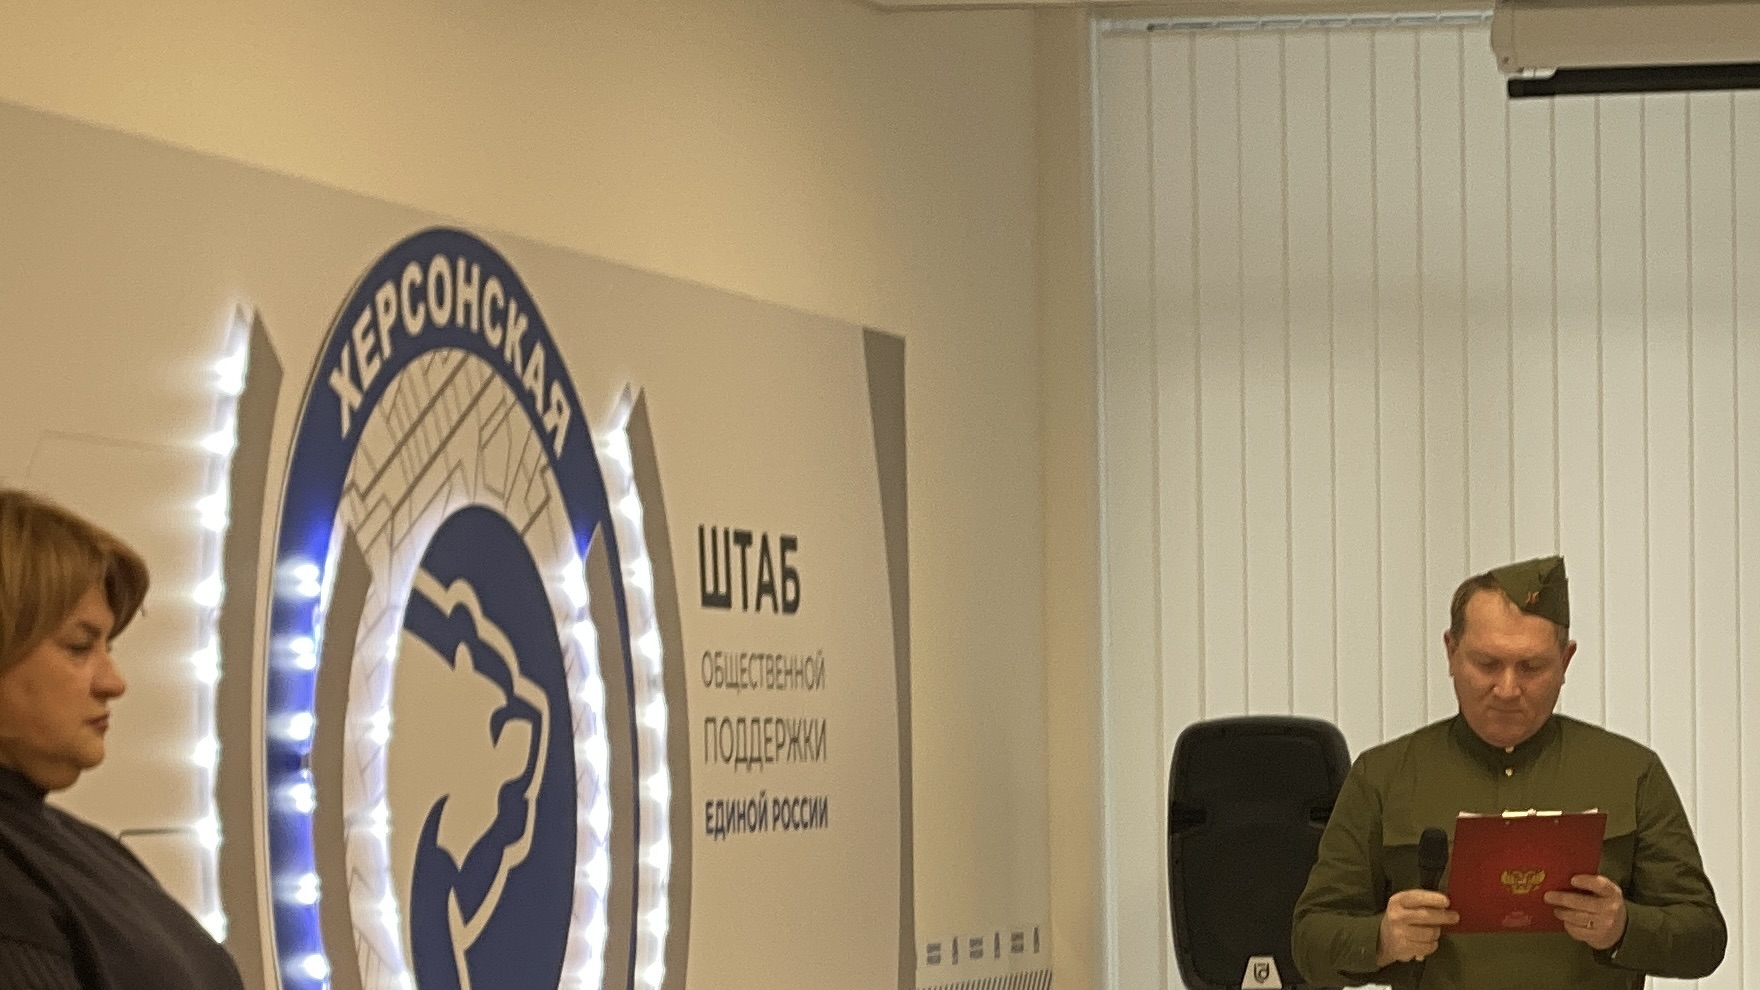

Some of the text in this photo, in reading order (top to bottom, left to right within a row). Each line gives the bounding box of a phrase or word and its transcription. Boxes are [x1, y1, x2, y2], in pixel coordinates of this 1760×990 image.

[328, 253, 571, 459] ХЕРСОНСКАЯ
[698, 523, 801, 615] ШТАБ
[701, 649, 826, 693] ОБЩЕСТВЕННОЙ
[703, 716, 828, 773] ПОДДЕРЖКИ
[704, 790, 829, 842] ЕДИНОЙ РОССИИ
